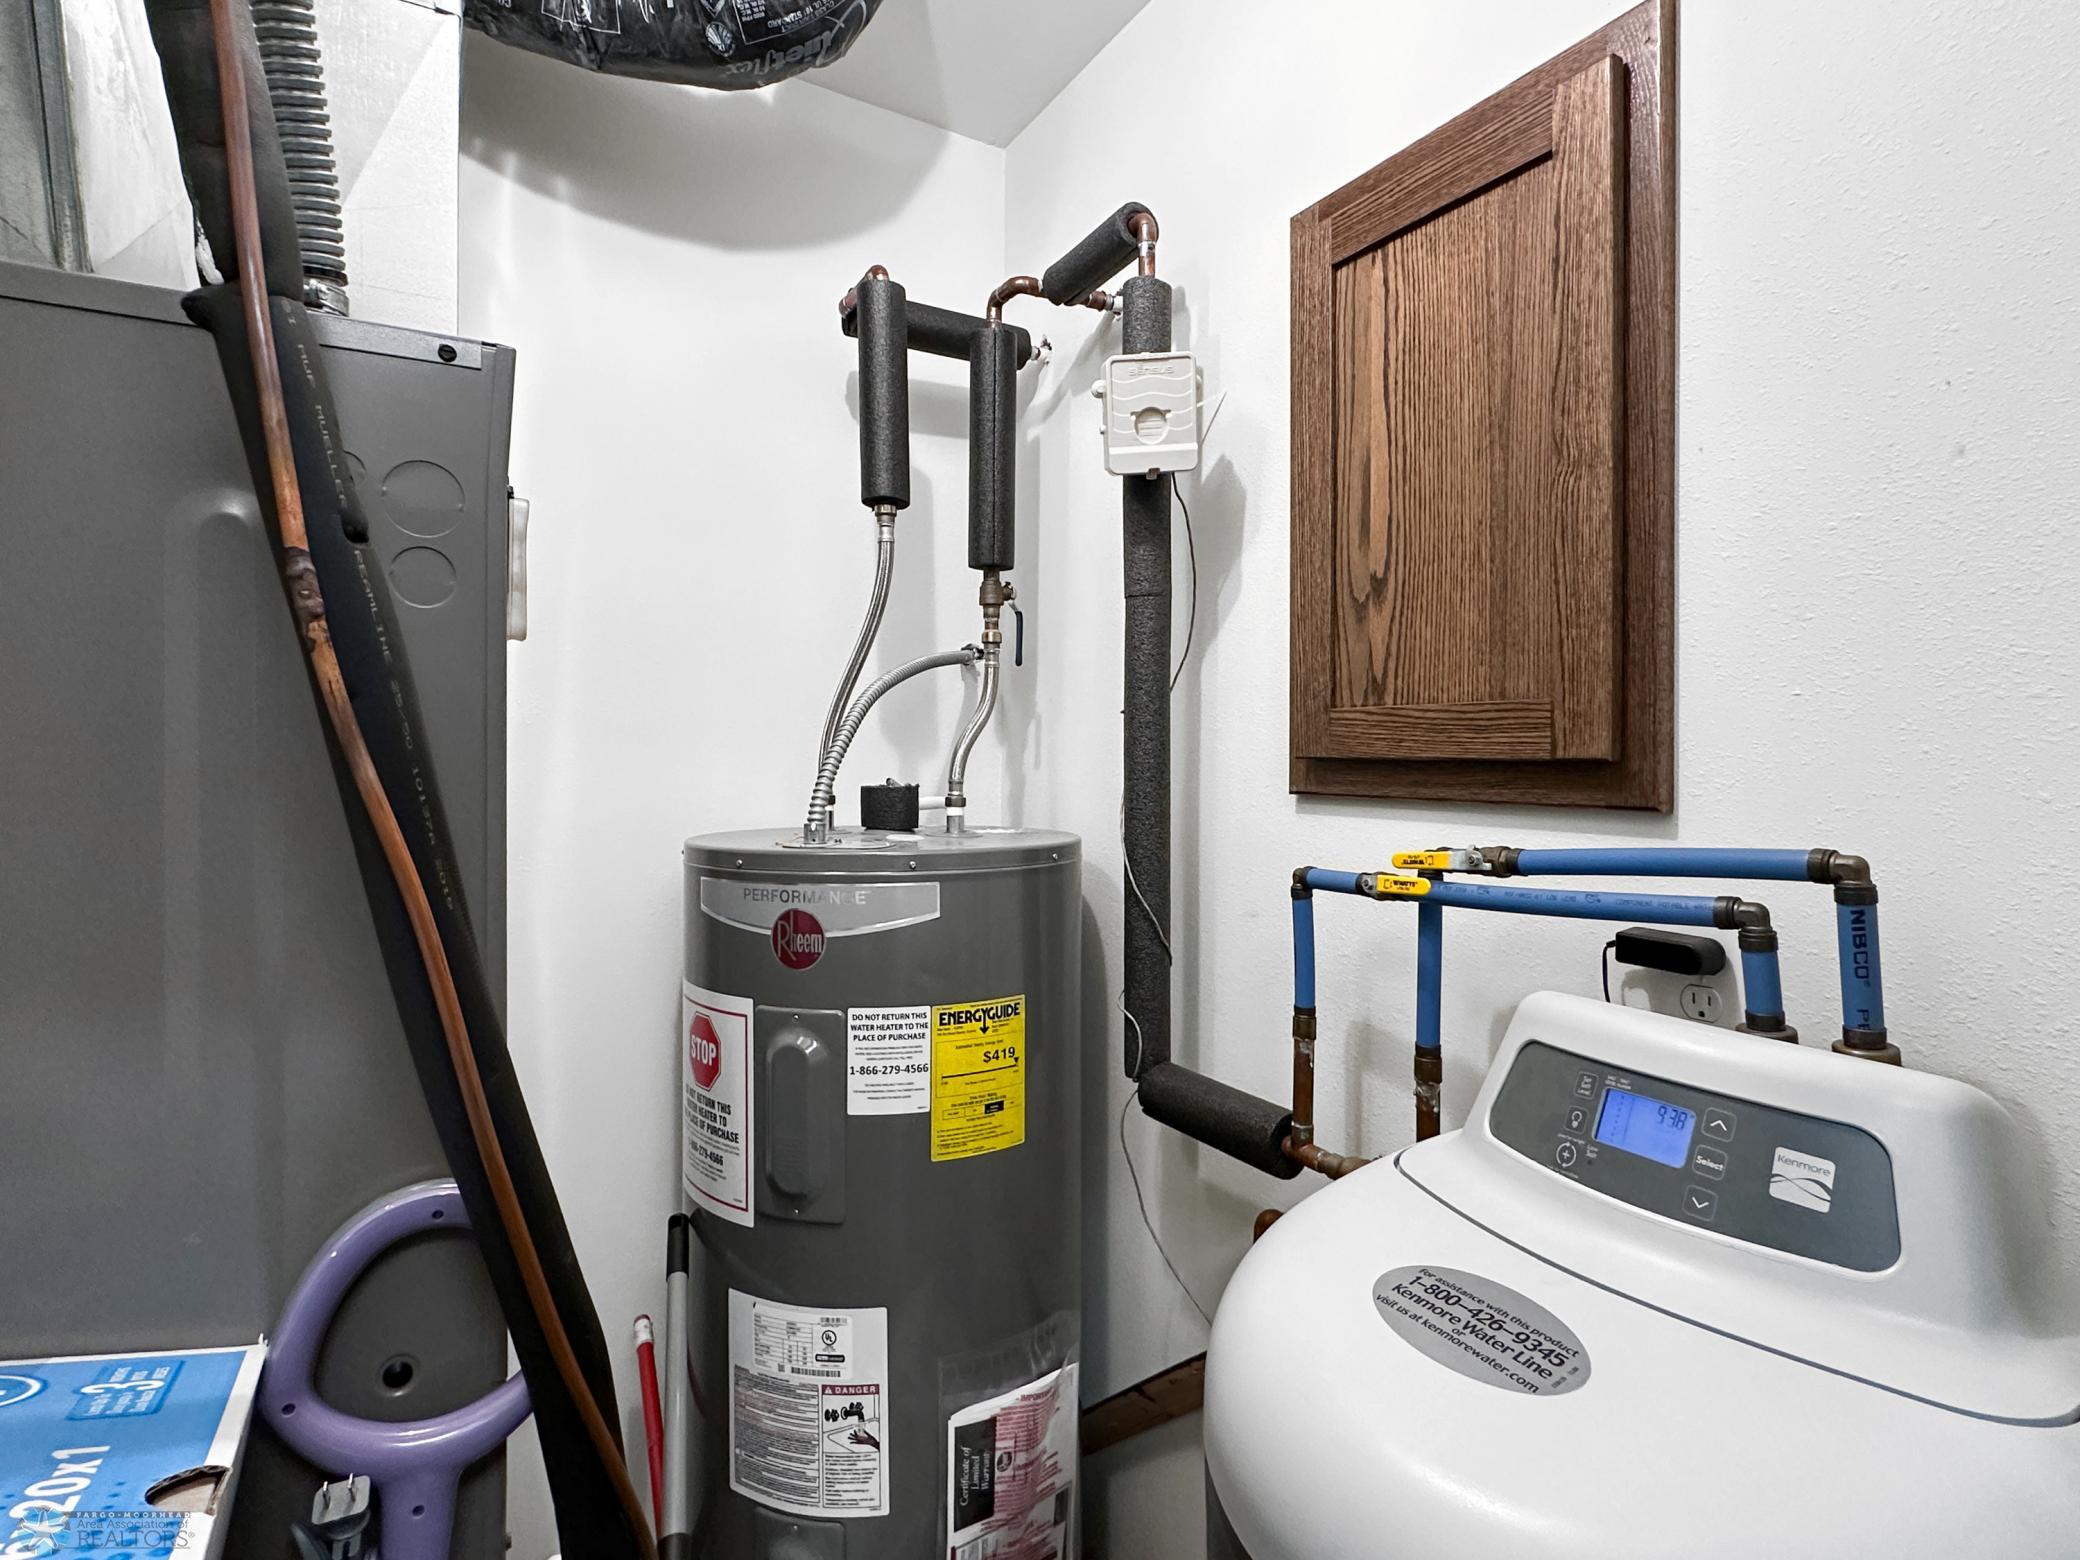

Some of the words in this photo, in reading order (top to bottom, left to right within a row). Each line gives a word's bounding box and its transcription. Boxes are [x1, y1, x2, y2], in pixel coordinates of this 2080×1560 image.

[354, 549, 392, 665] REAMLINE
[776, 910, 823, 961] Rheem
[850, 1023, 875, 1032] WATER
[876, 1022, 903, 1031] HEATER
[904, 1021, 915, 1030] TO
[915, 1021, 929, 1029] THE
[852, 1013, 863, 1021] DO
[865, 1013, 881, 1021] NOT
[881, 1012, 910, 1021] RETURN
[911, 1011, 928, 1020] THIS
[938, 1002, 1021, 1028] ENERGYGUIDE
[853, 1034, 876, 1042] PLACE
[877, 1033, 887, 1041] OF
[888, 1032, 926, 1041] PURCHASE
[690, 1034, 717, 1067] STOP
[982, 1045, 1016, 1064] $419
[849, 1062, 930, 1076] 1-866-279-4566
[698, 1104, 718, 1124] HEATER
[719, 1114, 727, 1127] TO
[717, 1101, 732, 1116] THIS
[706, 1123, 740, 1144] PURCHASE
[1694, 1155, 1725, 1172] Select
[1777, 1153, 1831, 1177] Kenmore
[1407, 1274, 1570, 1368] 1-800-426-9345
[1434, 1275, 1486, 1306] assistance
[1485, 1301, 1511, 1320] with
[1509, 1313, 1532, 1331] this
[1530, 1326, 1580, 1358] product
[1391, 1282, 1462, 1326] Kenmore
[1461, 1318, 1516, 1355] Water
[1511, 1349, 1554, 1380] Line
[1451, 1326, 1467, 1338] or
[1375, 1292, 1401, 1309] visit
[1396, 1304, 1410, 1317] us
[1407, 1310, 1423, 1324] at
[1420, 1316, 1541, 1395] kenmorewater.com
[835, 1386, 877, 1395] DANGER
[960, 1458, 971, 1507] Certificate
[971, 1455, 980, 1490] Limited
